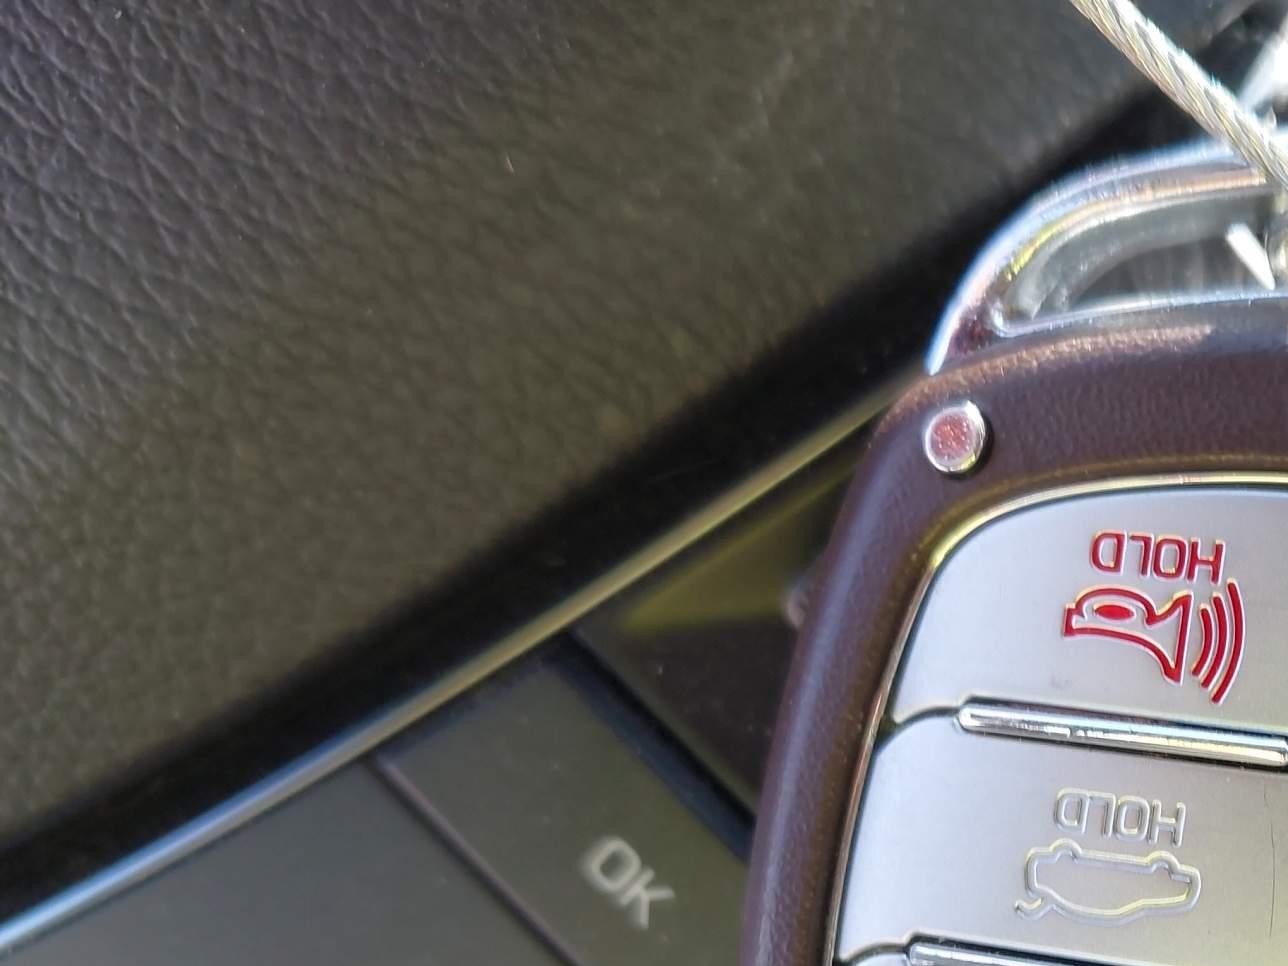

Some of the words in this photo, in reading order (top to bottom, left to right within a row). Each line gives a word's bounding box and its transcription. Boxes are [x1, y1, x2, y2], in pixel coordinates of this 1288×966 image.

[1090, 530, 1226, 585] HOLD
[1054, 788, 1187, 848] HOLD
[582, 836, 675, 930] OK
